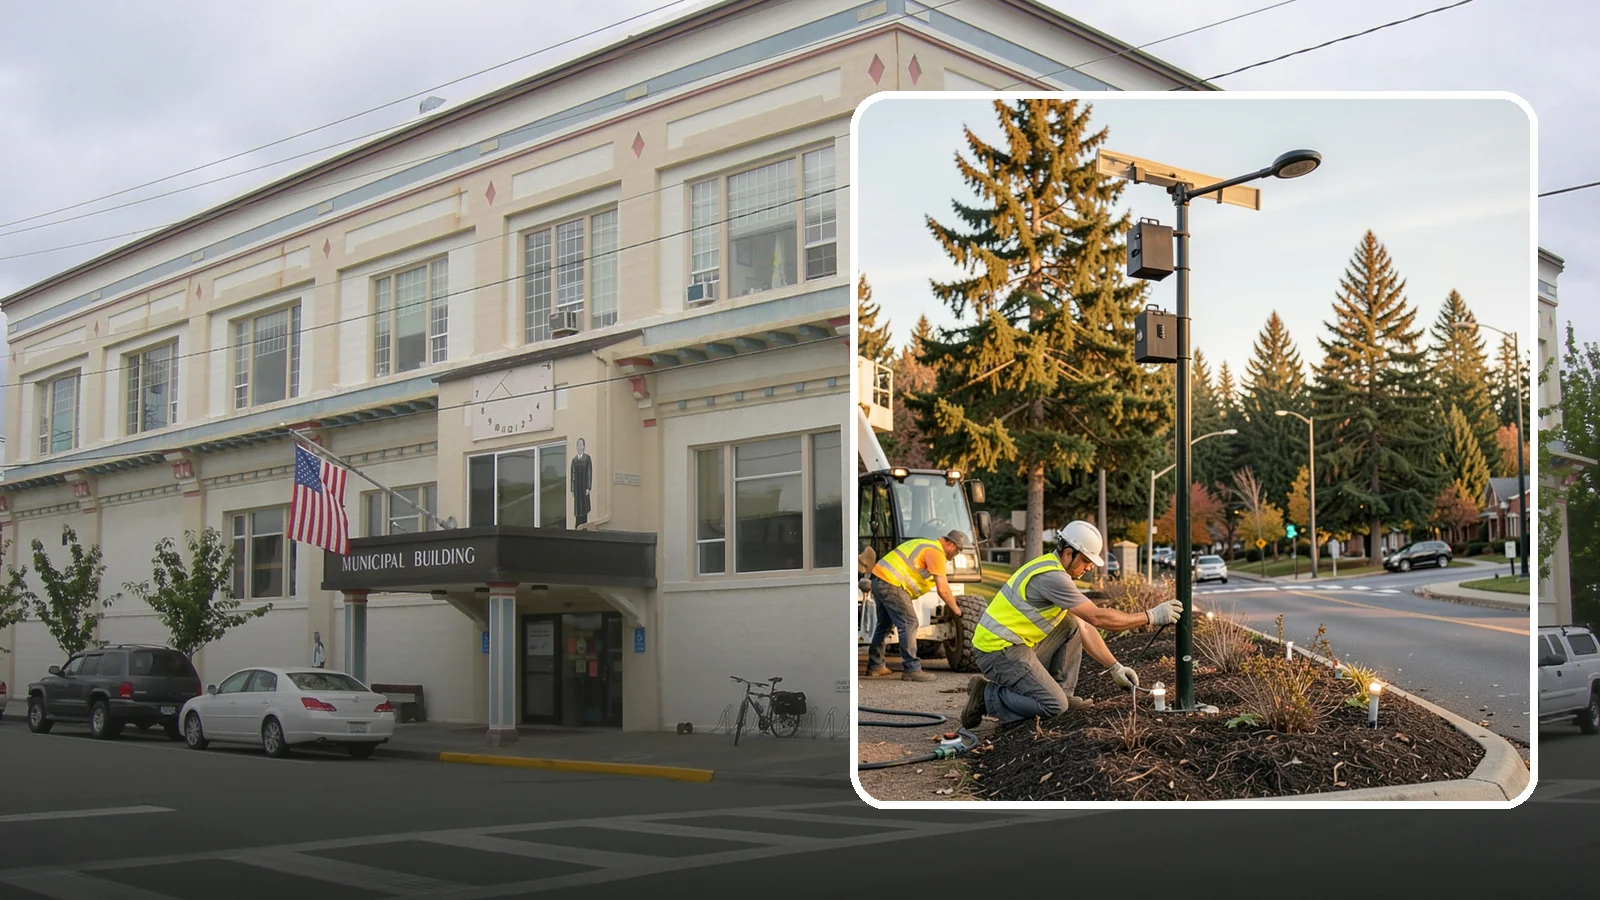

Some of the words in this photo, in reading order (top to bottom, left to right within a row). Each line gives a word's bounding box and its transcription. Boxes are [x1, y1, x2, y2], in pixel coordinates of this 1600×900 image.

[480, 407, 485, 415] 8
[488, 418, 492, 426] 9
[494, 423, 500, 432] 10
[529, 414, 533, 422] 3
[342, 552, 404, 572] MUNICIPAL
[414, 546, 475, 567] BUILDING
